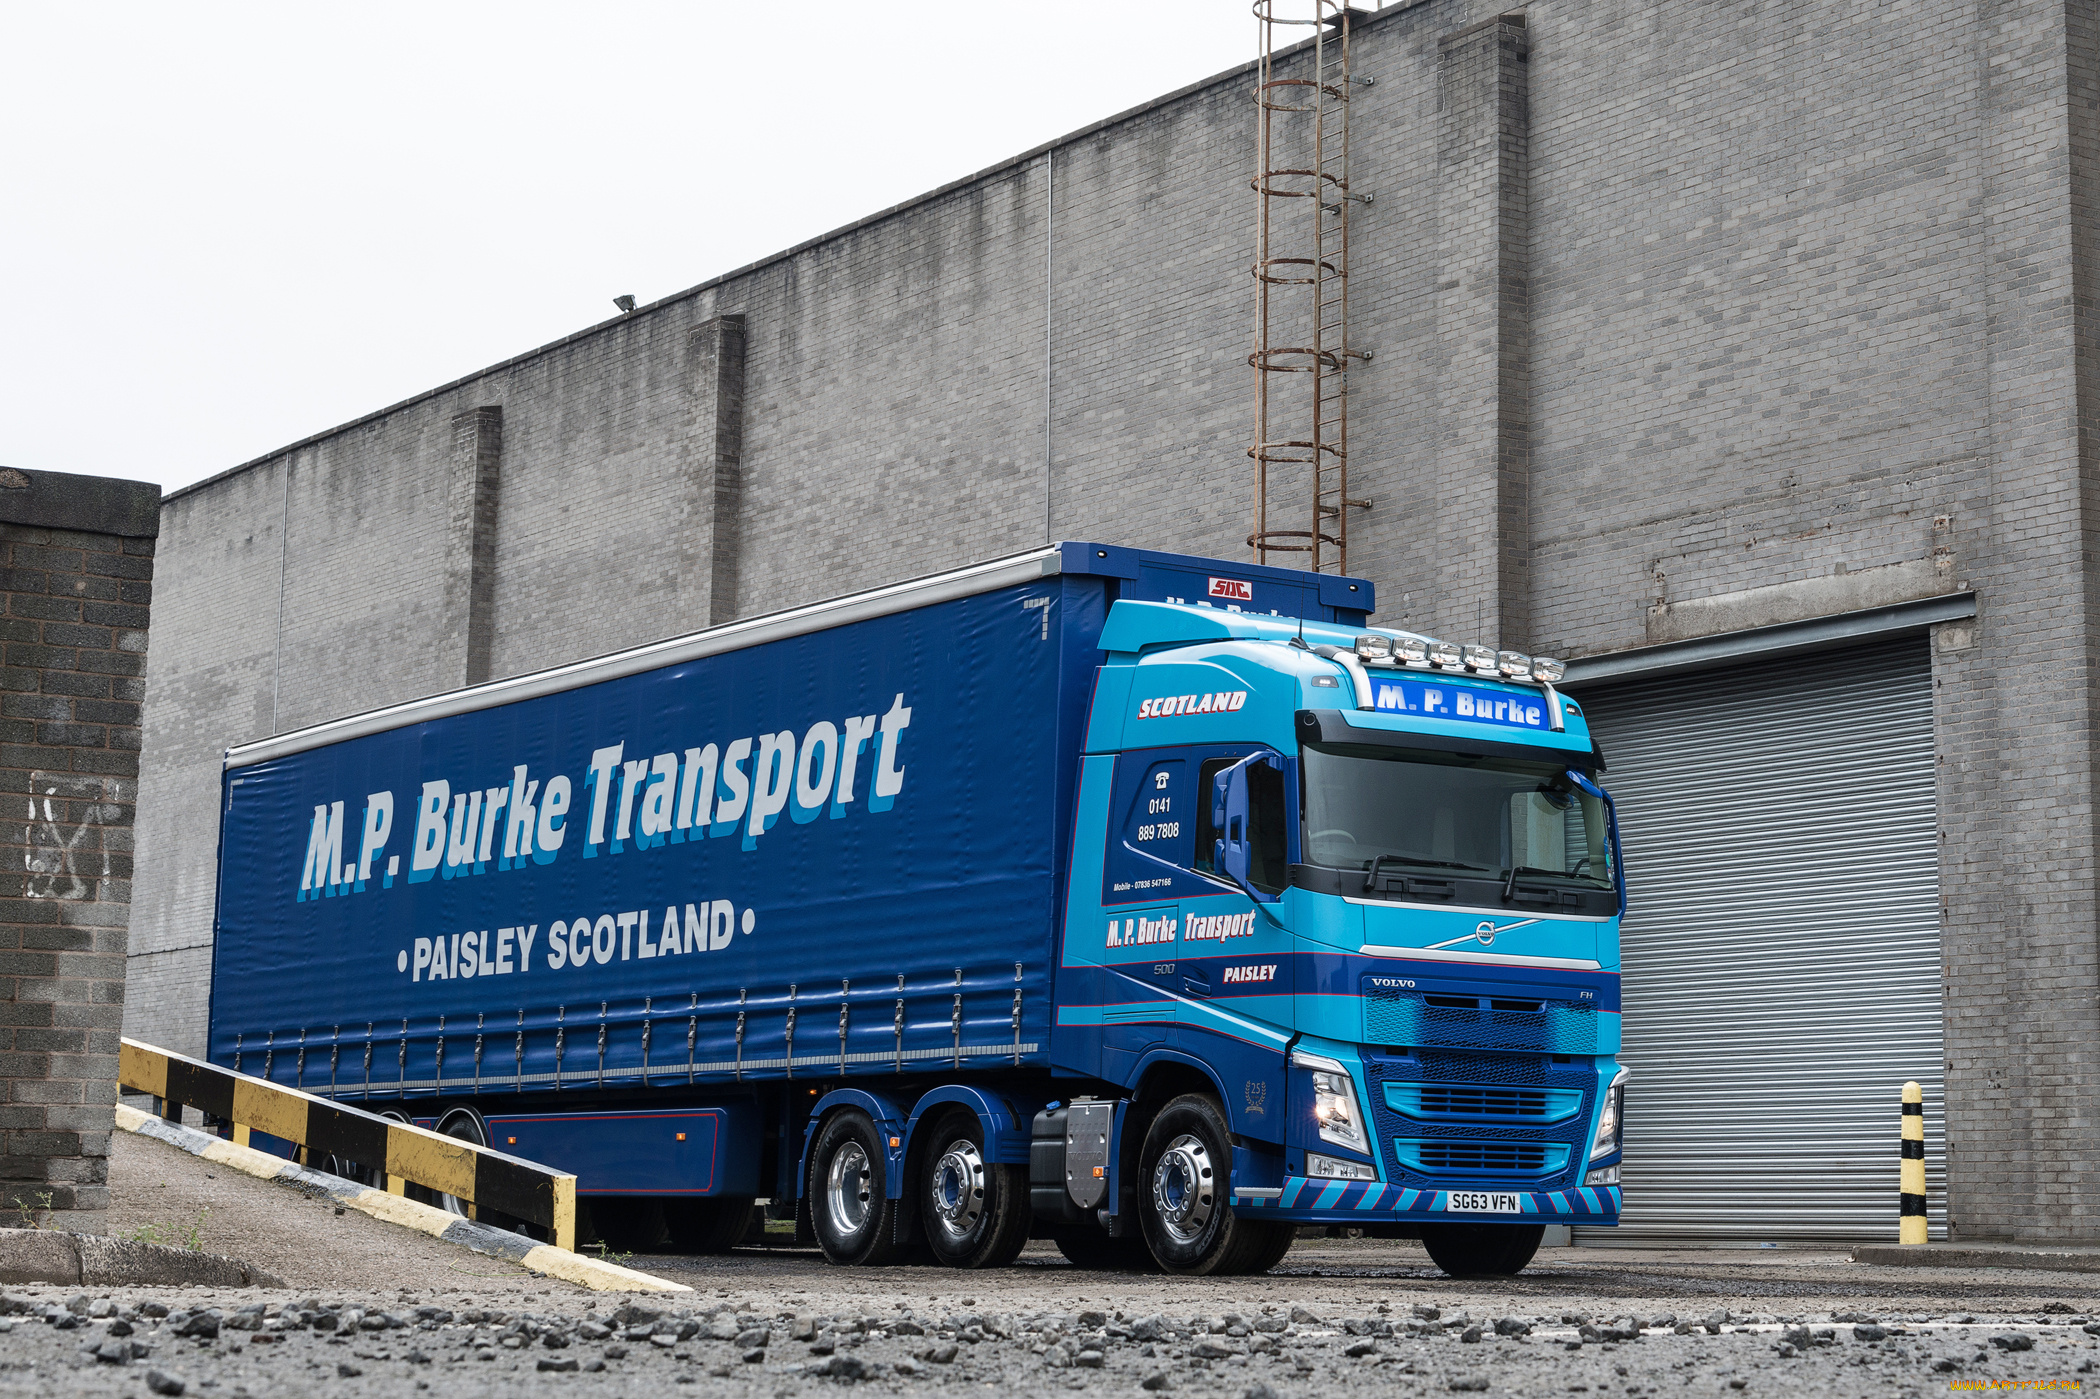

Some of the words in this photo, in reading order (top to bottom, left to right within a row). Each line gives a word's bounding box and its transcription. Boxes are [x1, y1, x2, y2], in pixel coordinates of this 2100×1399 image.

[1137, 691, 1247, 720] SCOTLAND
[1377, 684, 1417, 711] M.
[1424, 688, 1448, 714] P.
[1456, 691, 1541, 726] Burke
[410, 763, 573, 878] Burke
[585, 692, 912, 850] Transport
[1148, 797, 1171, 815] 0141
[1138, 825, 1155, 842] 889
[1156, 822, 1180, 839] 7808
[1113, 882, 1131, 892] Mobile
[1134, 879, 1151, 889] 07836
[1137, 915, 1178, 945] Burke
[1184, 909, 1256, 943] Transport
[412, 924, 538, 982] PAISLEY
[547, 899, 735, 970] SCOTLAND
[1154, 963, 1176, 975] 500
[1223, 965, 1277, 984] PAISLEY
[1371, 978, 1416, 989] VOLVO
[1580, 991, 1593, 1000] FH
[1251, 1082, 1261, 1094] 25
[1453, 1193, 1487, 1209] SG63
[1492, 1195, 1516, 1210] VFN
